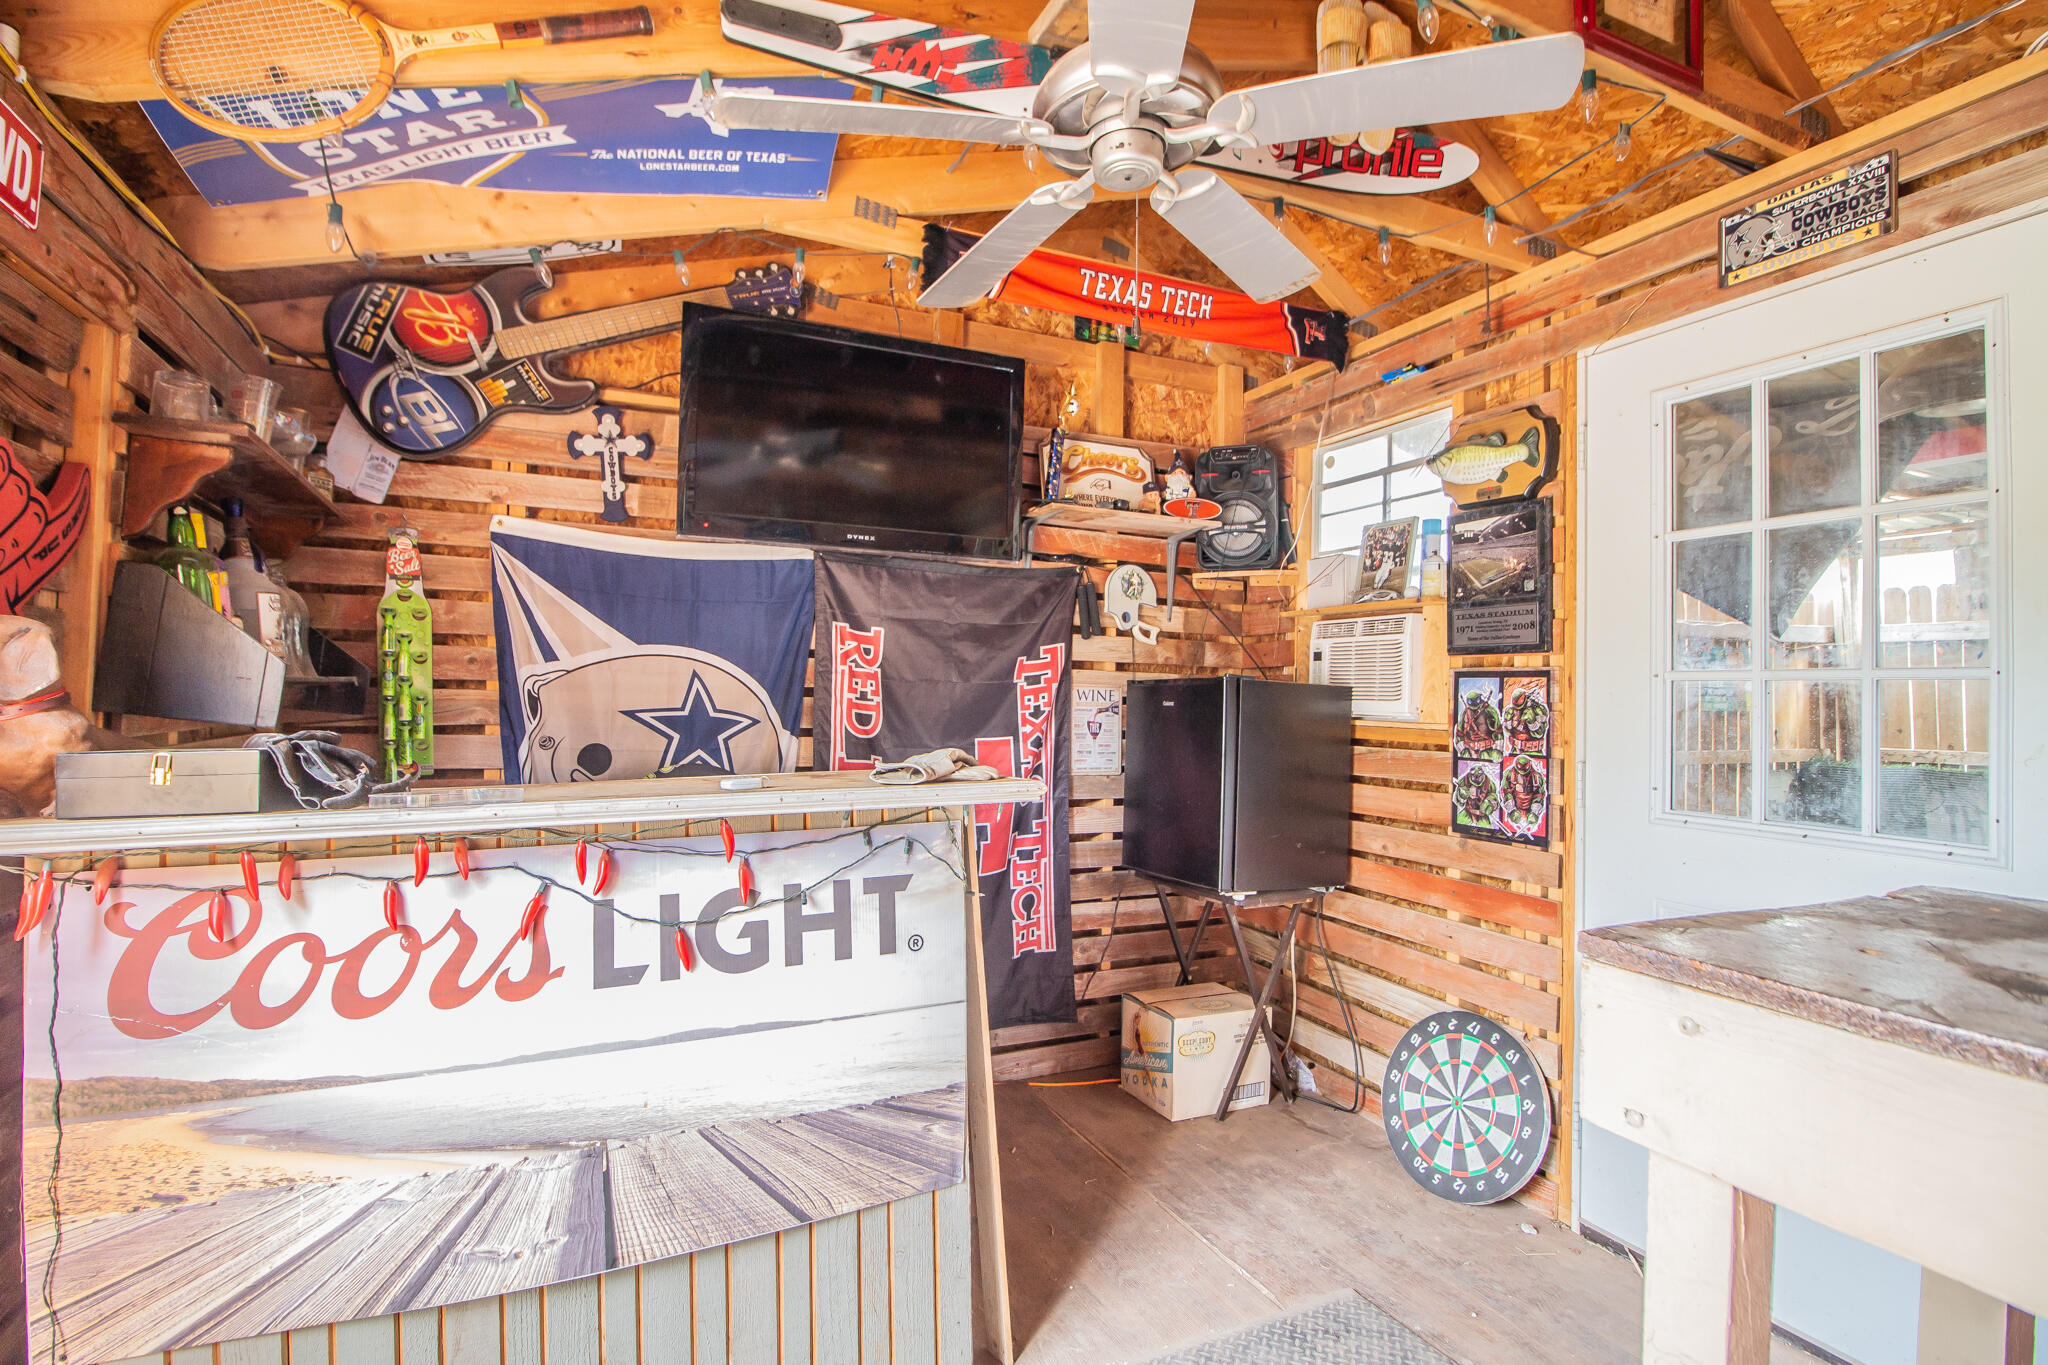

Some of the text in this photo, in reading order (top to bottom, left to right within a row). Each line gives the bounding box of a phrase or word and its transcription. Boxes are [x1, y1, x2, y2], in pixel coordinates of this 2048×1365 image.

[297, 108, 508, 168] STAR
[317, 130, 552, 194] TEXAS LIGHT BEER
[590, 148, 786, 164] The NATIONAL BEER OF TEXAS
[639, 162, 740, 173] LONESTARBEER.COM
[1767, 174, 1833, 205] DALLAS
[1771, 166, 1886, 217] SUPERBOWL XXVIII
[1792, 176, 1887, 218] DALLAS
[1791, 184, 1888, 231] COWBOYS
[1801, 201, 1886, 238] BACK TO BACK
[1801, 211, 1888, 247] CHAMPIONS
[1748, 233, 1856, 276] COWBOYS
[1080, 268, 1213, 319] TEXAS TECH
[360, 285, 401, 353] TRUE
[1061, 444, 1147, 483] Cheers
[607, 447, 617, 500] COWBOYS
[388, 549, 418, 563] Beer
[394, 559, 421, 576] Salt
[1456, 609, 1534, 620] TEXAS STADIUM
[1456, 625, 1474, 634] 1971
[1512, 620, 1536, 631] 2008
[839, 624, 885, 738] RED
[1076, 689, 1116, 702] WINE
[1009, 818, 1048, 960] TECH
[104, 874, 914, 1040] Coors LIGHT
[1427, 1021, 1440, 1035] 15
[1448, 1018, 1458, 1030] 2
[1466, 1022, 1481, 1036] 17
[1410, 1033, 1422, 1047] 10
[1490, 1032, 1501, 1045] 3
[1123, 1050, 1168, 1071] American
[1505, 1049, 1520, 1064] 19
[1123, 1072, 1168, 1089] VODKA
[1390, 1069, 1401, 1083] 13
[1519, 1074, 1531, 1086] 7
[1388, 1093, 1397, 1103] 4
[1522, 1099, 1536, 1115] 16
[1390, 1115, 1402, 1130] 18
[1521, 1126, 1532, 1139] 8
[1401, 1140, 1409, 1150] 1
[1413, 1156, 1429, 1173] 20
[1510, 1148, 1524, 1166] 11
[1432, 1173, 1442, 1185] 5
[1494, 1167, 1509, 1185] 14
[1453, 1177, 1467, 1195] 12
